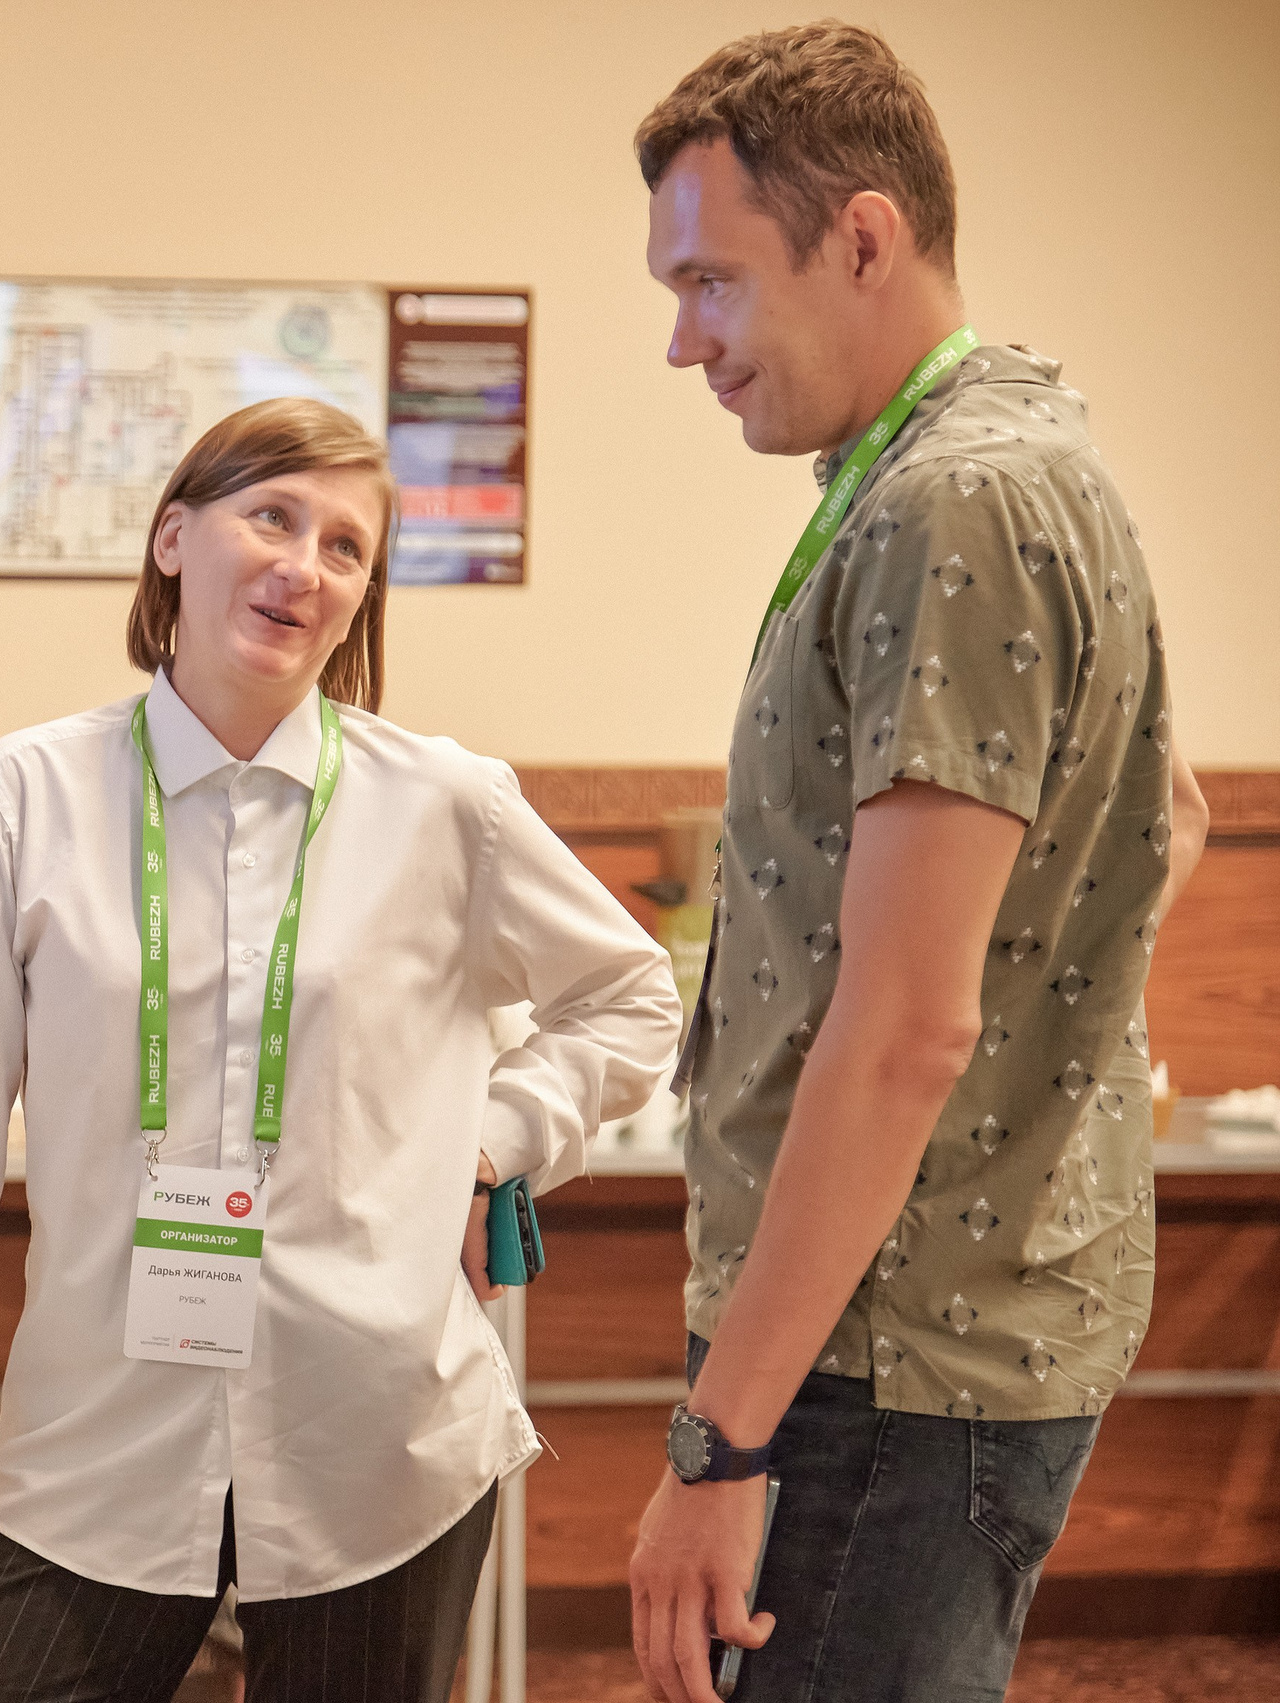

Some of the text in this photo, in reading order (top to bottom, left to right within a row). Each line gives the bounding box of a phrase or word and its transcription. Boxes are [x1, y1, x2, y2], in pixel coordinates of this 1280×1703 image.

[789, 556, 807, 580] 35
[816, 465, 860, 534] RUBEZH
[869, 421, 888, 445] 35
[903, 347, 958, 400] RUBEZH
[324, 726, 337, 780] RUBEZH
[147, 766, 161, 1103] RUBEZH 35 RUBEZH 35 RUBEZH
[272, 943, 289, 1010] RUBEZH
[270, 1033, 283, 1056] 35
[154, 1191, 211, 1207] РУБЕЖ
[229, 1197, 249, 1208] 35
[160, 1230, 239, 1246] ОРГАНИЗАТОР
[148, 1265, 243, 1283] Дарья ЖИГАНОВА
[179, 1295, 207, 1305] РУБЕЖ
